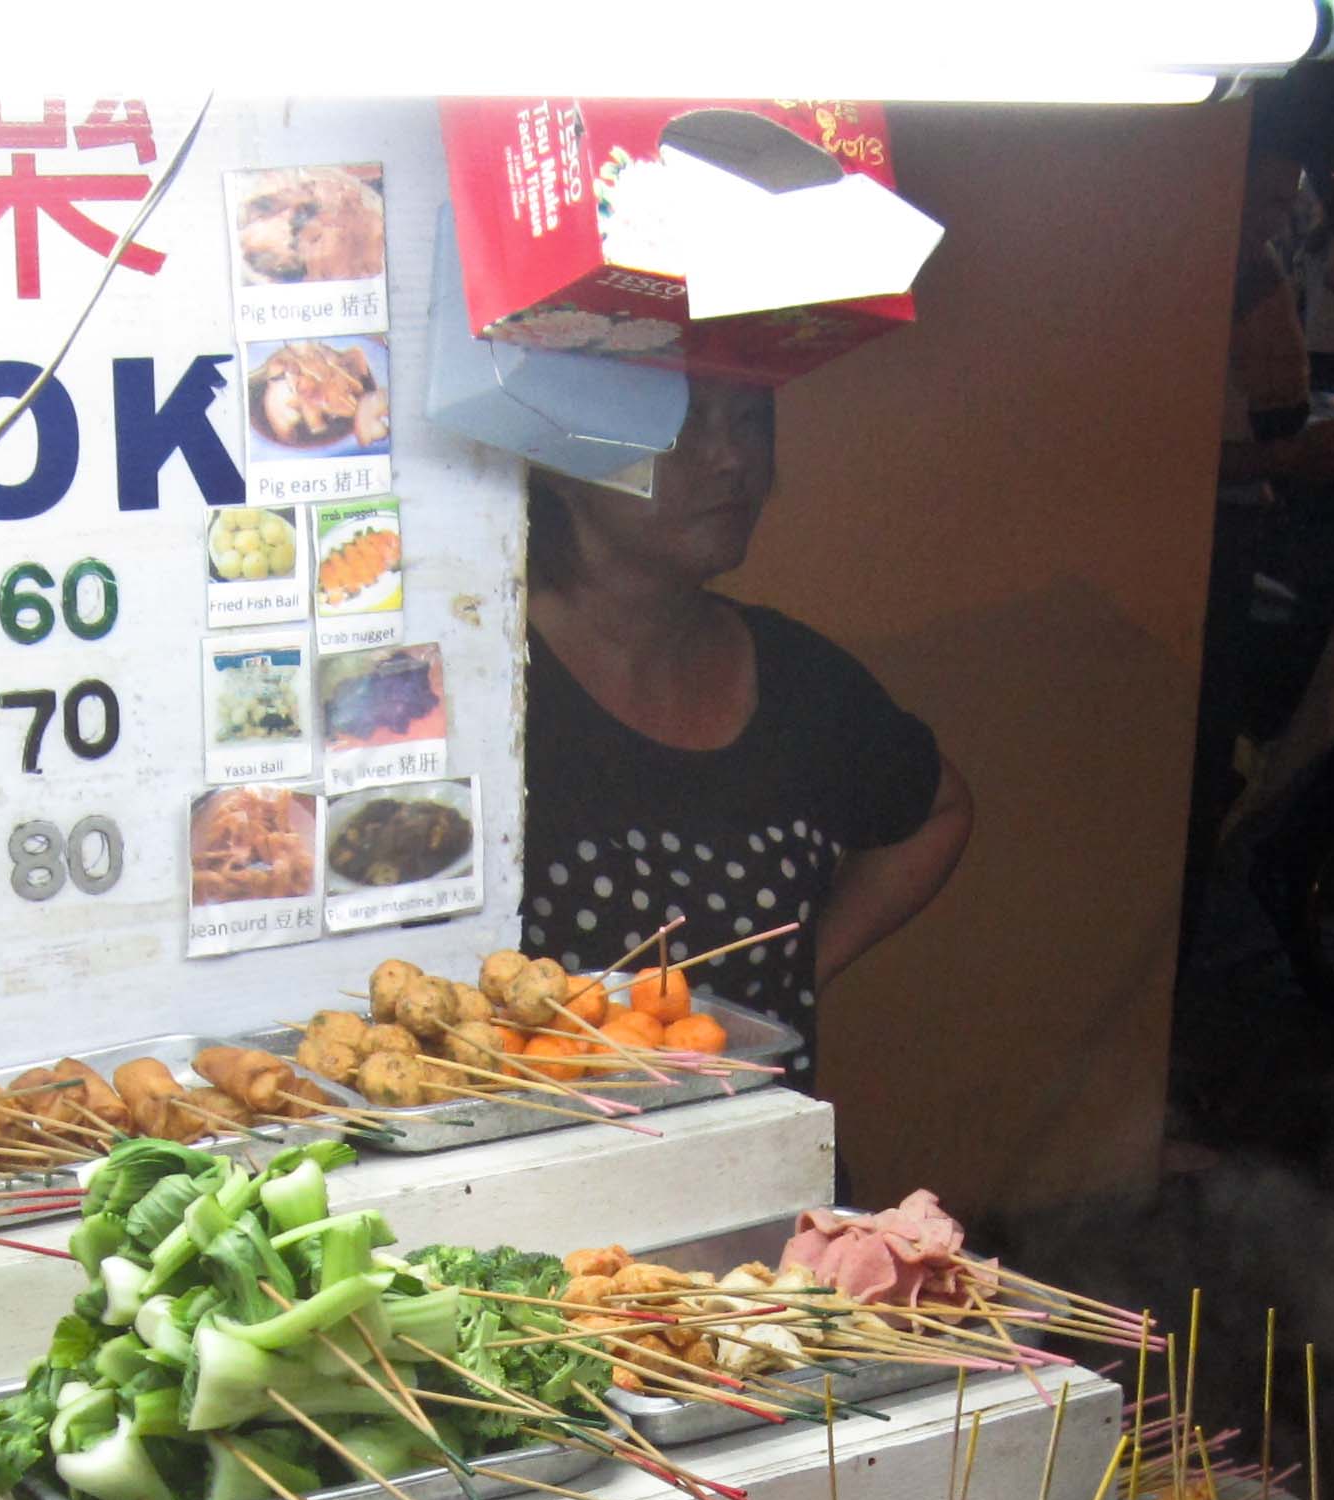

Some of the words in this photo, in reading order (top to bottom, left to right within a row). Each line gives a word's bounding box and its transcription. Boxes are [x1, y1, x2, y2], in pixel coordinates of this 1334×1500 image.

[517, 108, 539, 171] Facial
[532, 99, 550, 155] Tisu
[526, 171, 543, 238] Tissue
[540, 157, 559, 231] Muka
[607, 269, 686, 297] TESCO
[241, 304, 266, 325] Pig
[272, 302, 333, 322] tongue
[259, 478, 285, 498] Pig
[291, 478, 327, 494] ears
[210, 597, 243, 613] Fried
[247, 596, 272, 610] Fish
[276, 594, 299, 608] Ball
[321, 630, 349, 646] Crab
[353, 627, 395, 643] nugget
[226, 764, 258, 778] Yasai
[261, 759, 284, 775] Ball
[331, 768, 357, 787] Pg
[358, 762, 395, 778] iver
